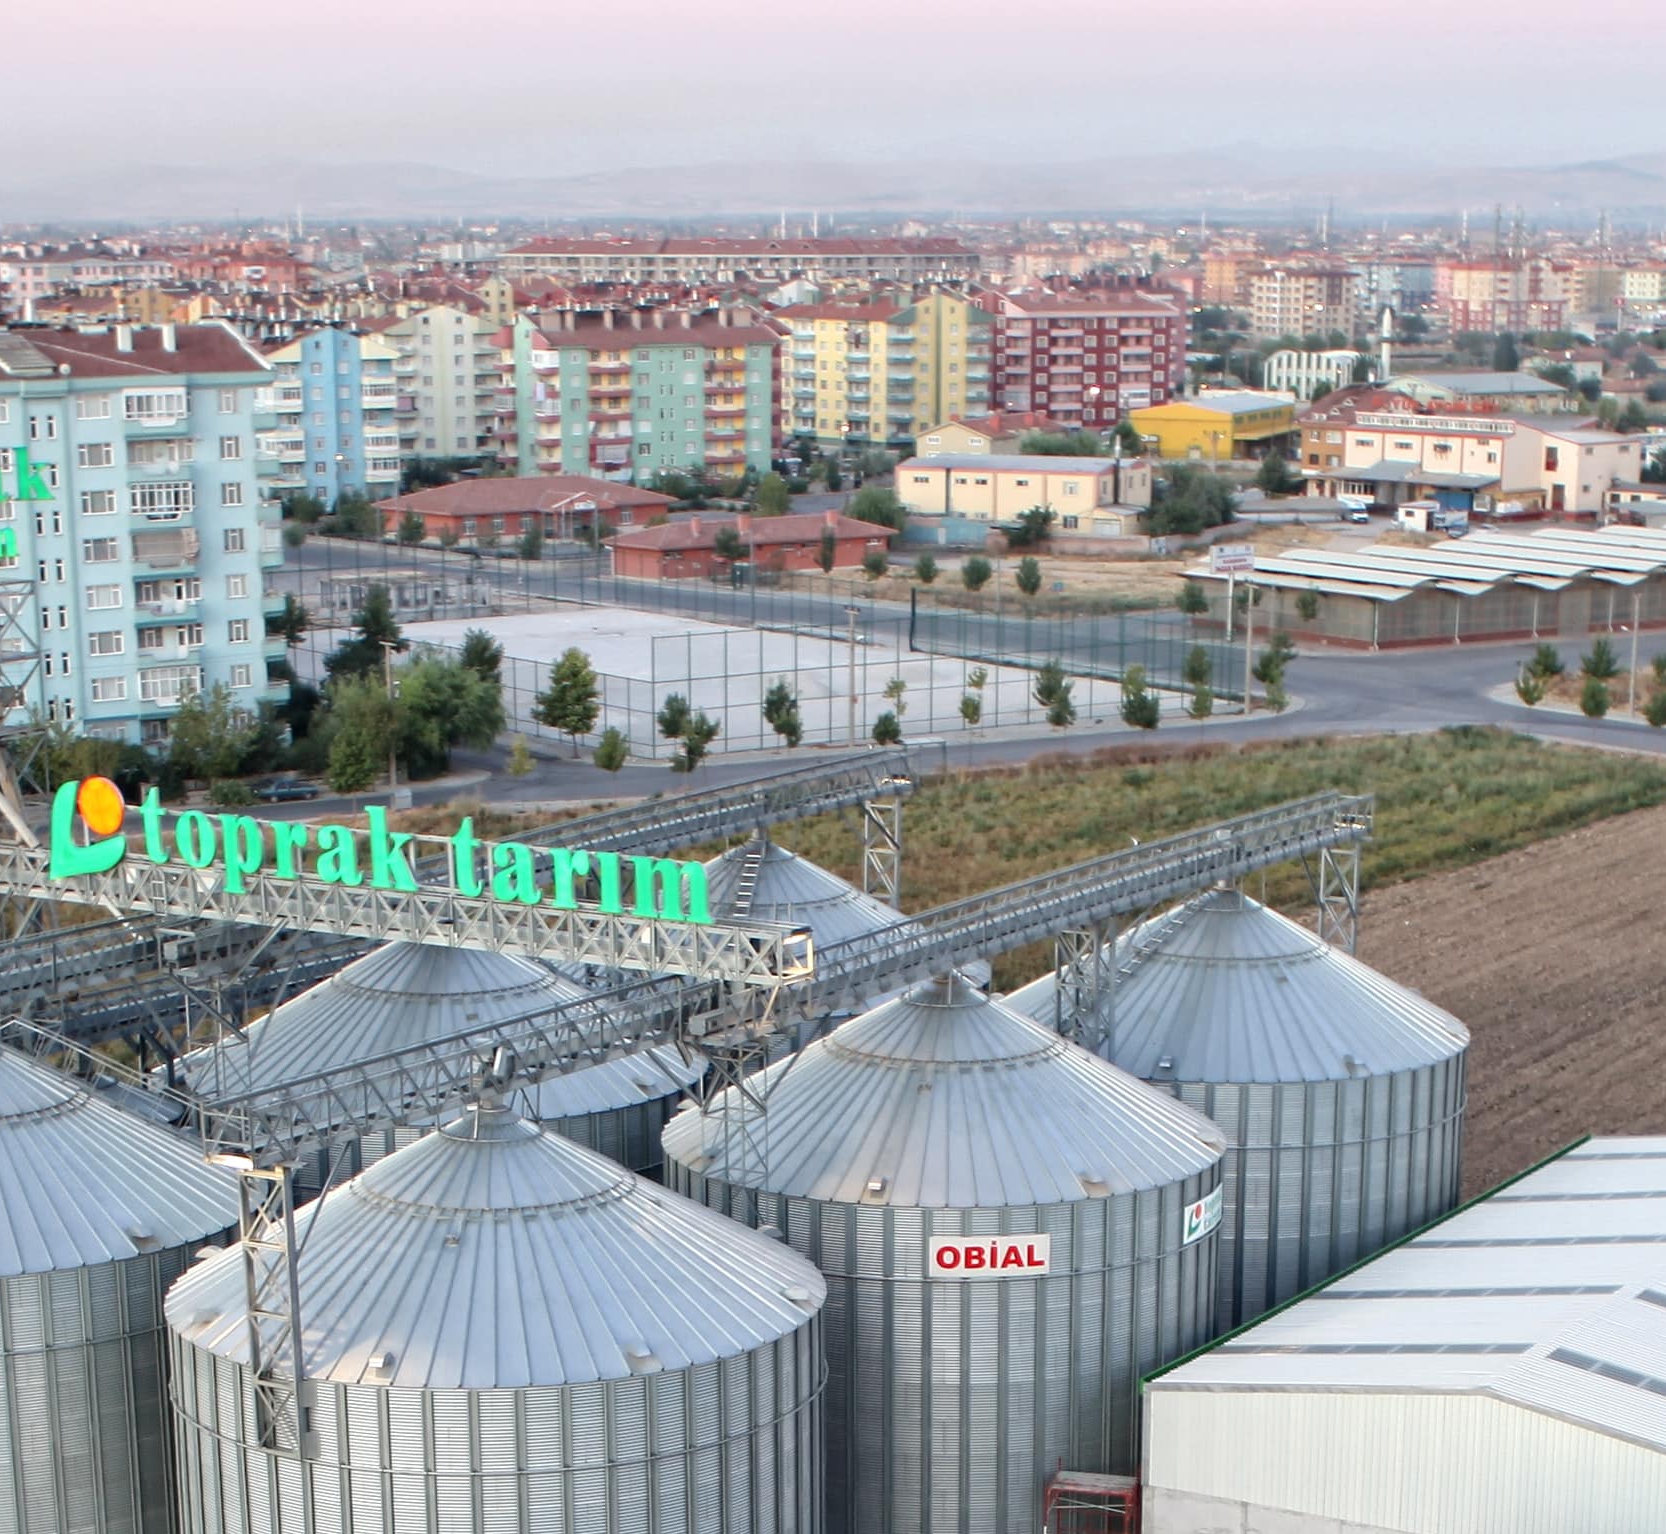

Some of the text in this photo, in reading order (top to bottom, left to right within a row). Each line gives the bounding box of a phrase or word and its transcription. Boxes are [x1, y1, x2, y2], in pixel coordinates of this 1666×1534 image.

[138, 786, 712, 924] toprak tarım
[935, 1240, 1045, 1269] OBİAL
